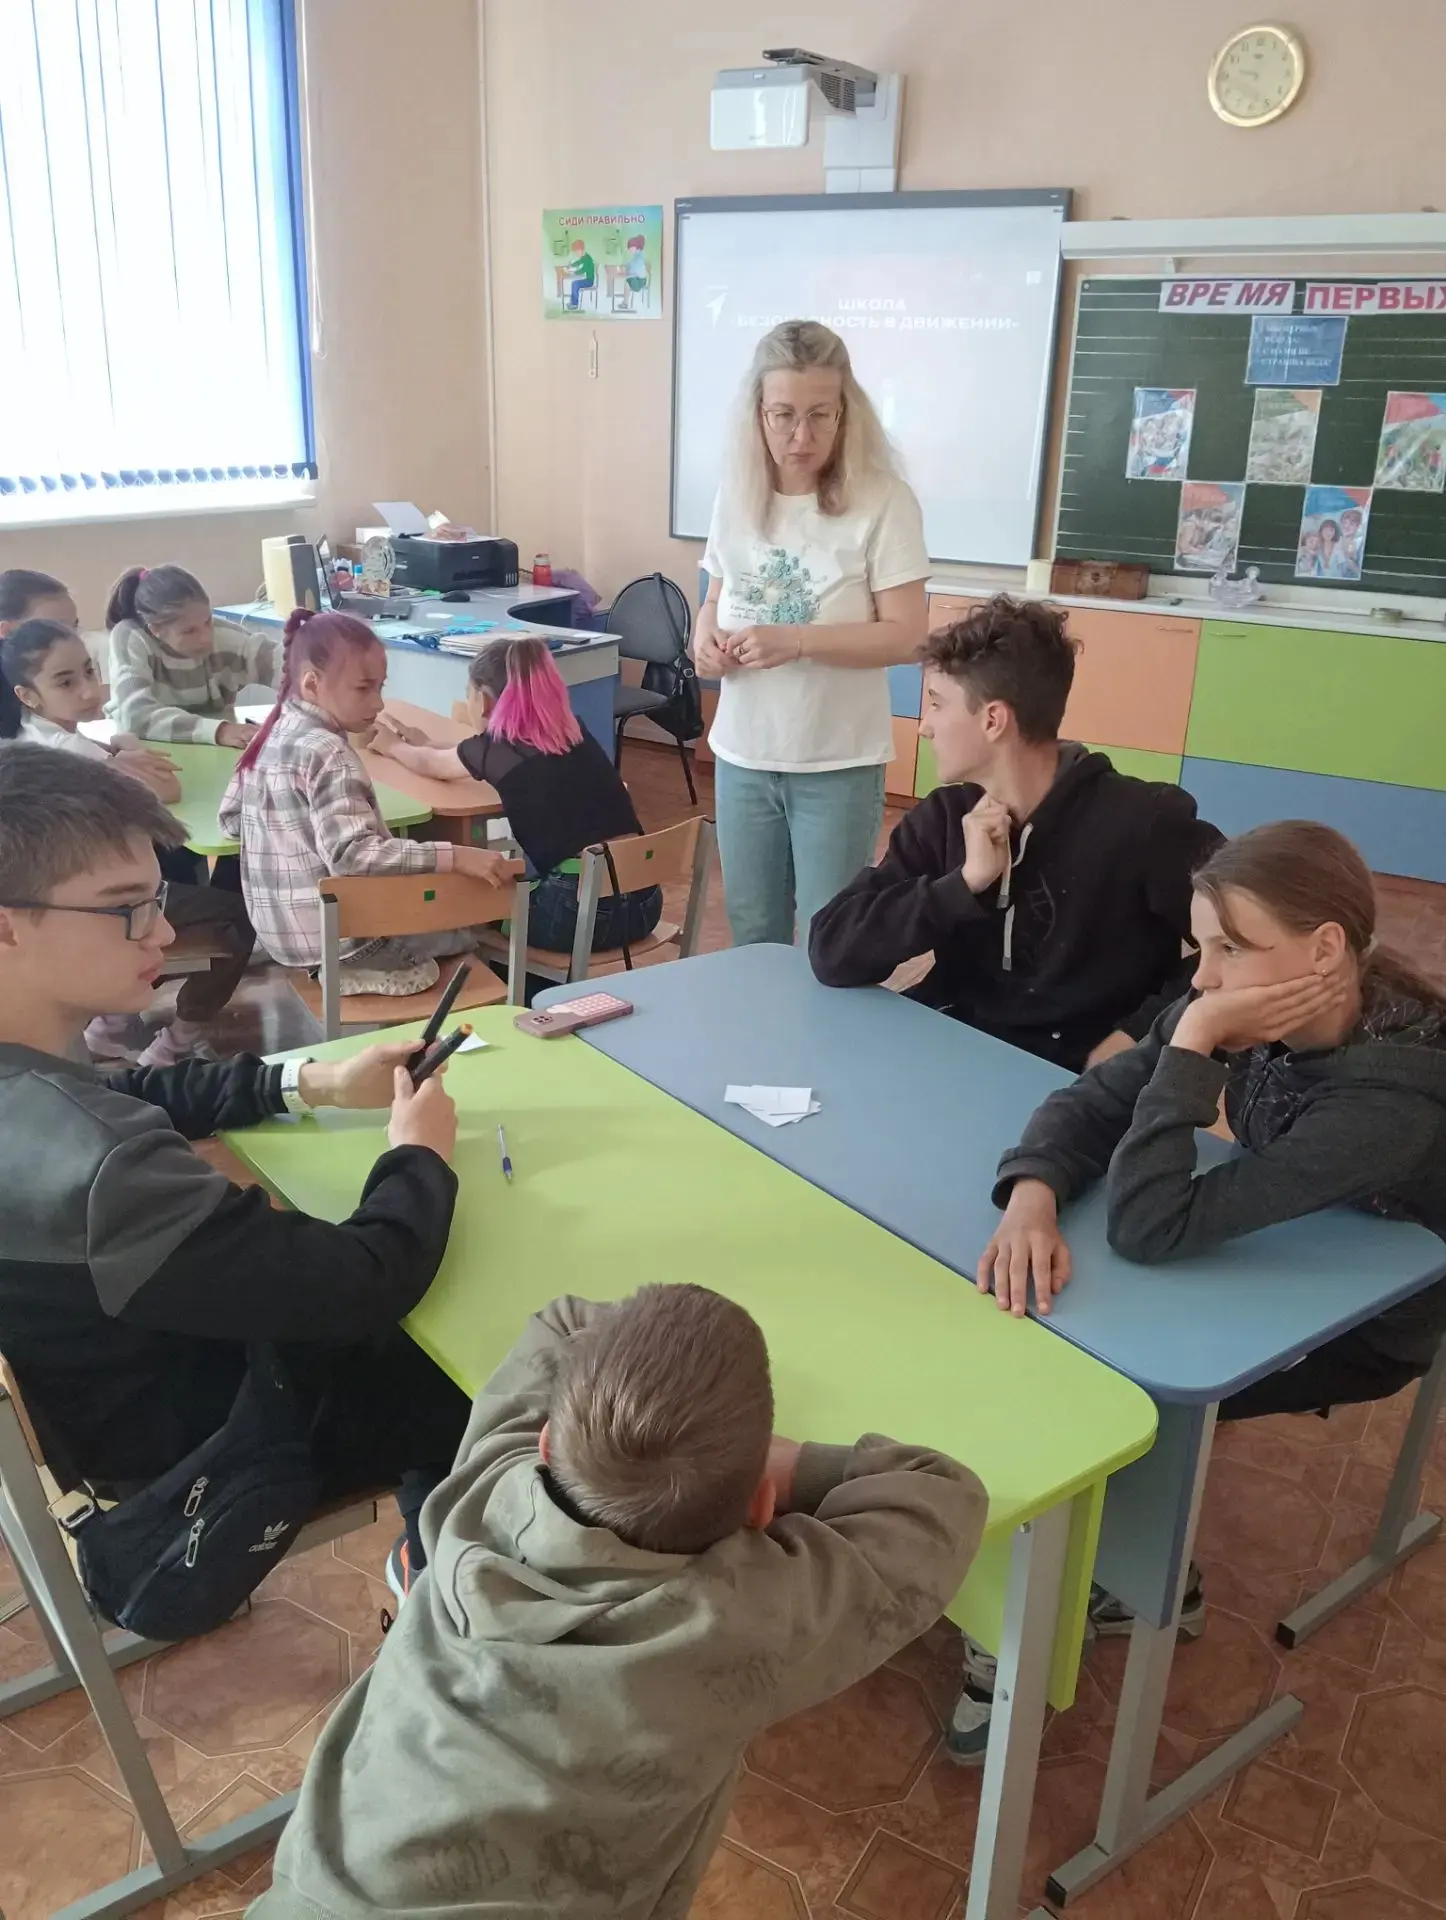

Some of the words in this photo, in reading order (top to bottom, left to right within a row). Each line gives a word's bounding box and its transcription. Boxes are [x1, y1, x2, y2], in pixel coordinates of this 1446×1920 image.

[558, 216, 584, 227] СИДИ
[586, 214, 646, 226] ПРАВИЛЬНО
[1164, 282, 1291, 307] ВРЕМЯ
[837, 298, 907, 311] ШКОЛА
[885, 316, 896, 329] В
